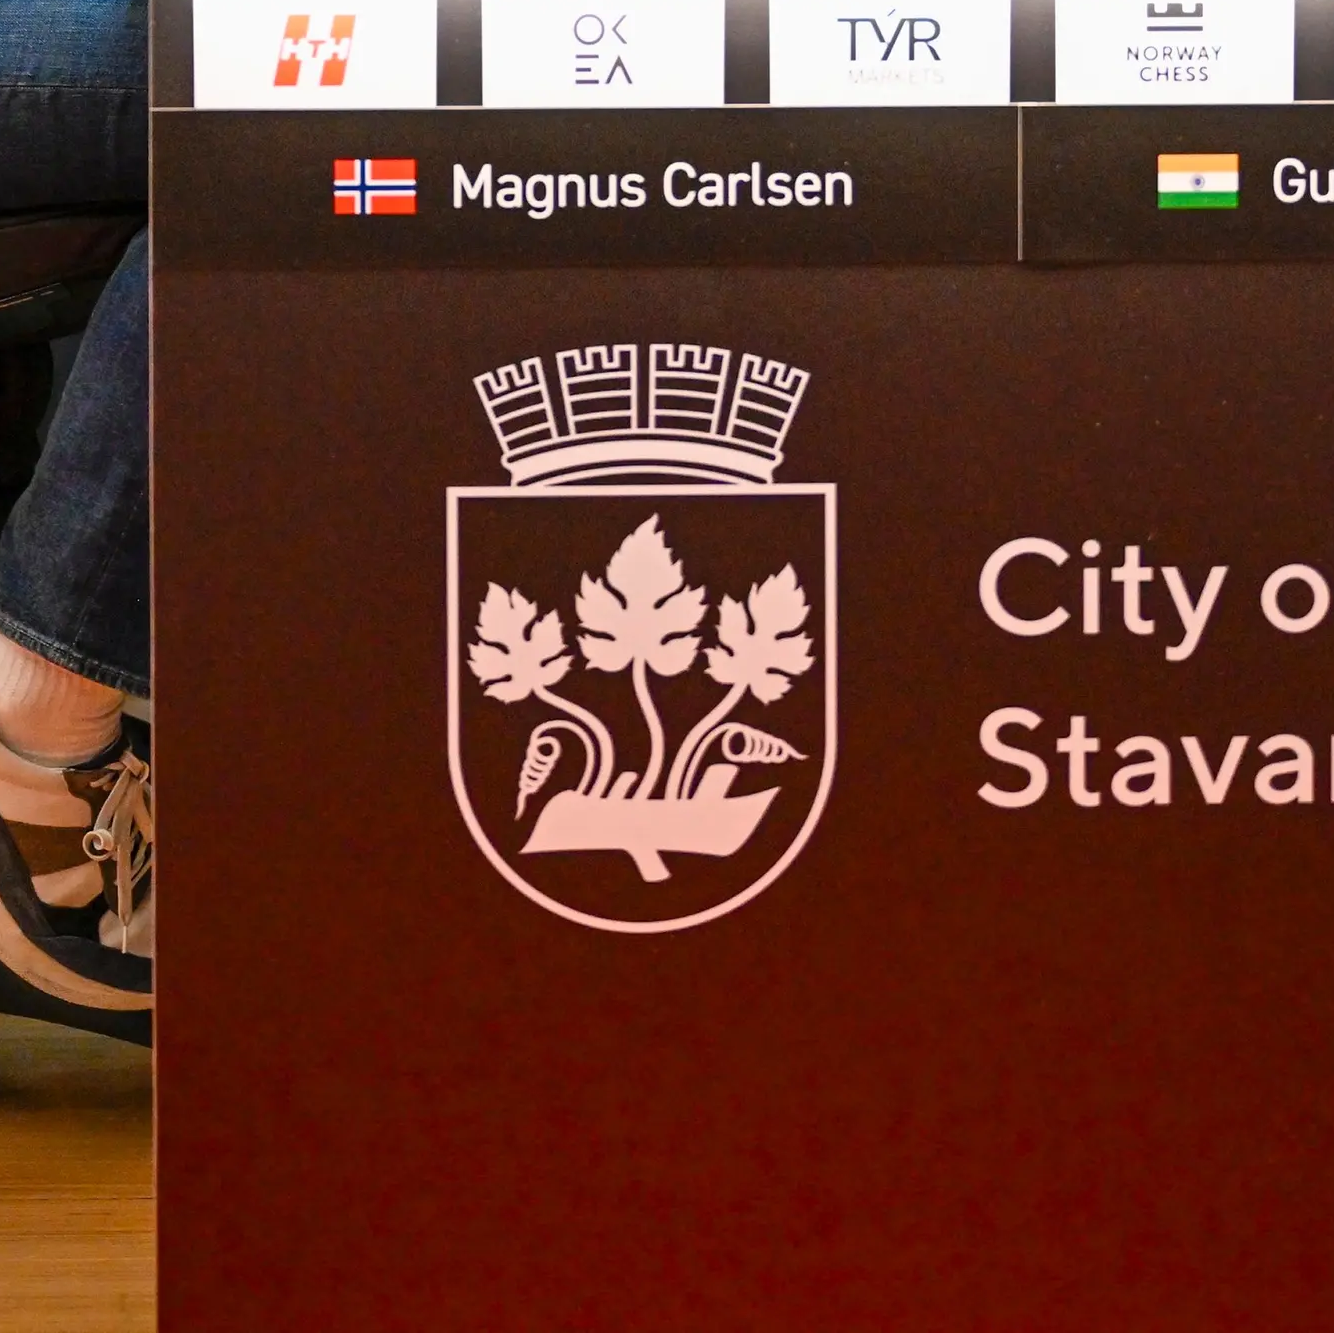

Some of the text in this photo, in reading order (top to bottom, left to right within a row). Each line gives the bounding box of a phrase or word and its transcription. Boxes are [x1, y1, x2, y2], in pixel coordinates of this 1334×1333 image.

[574, 14, 627, 45] OK
[1127, 46, 1221, 61] NORWAY
[576, 55, 632, 84] EA
[849, 67, 945, 84] MARKETS
[1140, 67, 1208, 81] CHESS
[454, 162, 852, 219] Magnus Carlsen
[979, 537, 1228, 661] City
